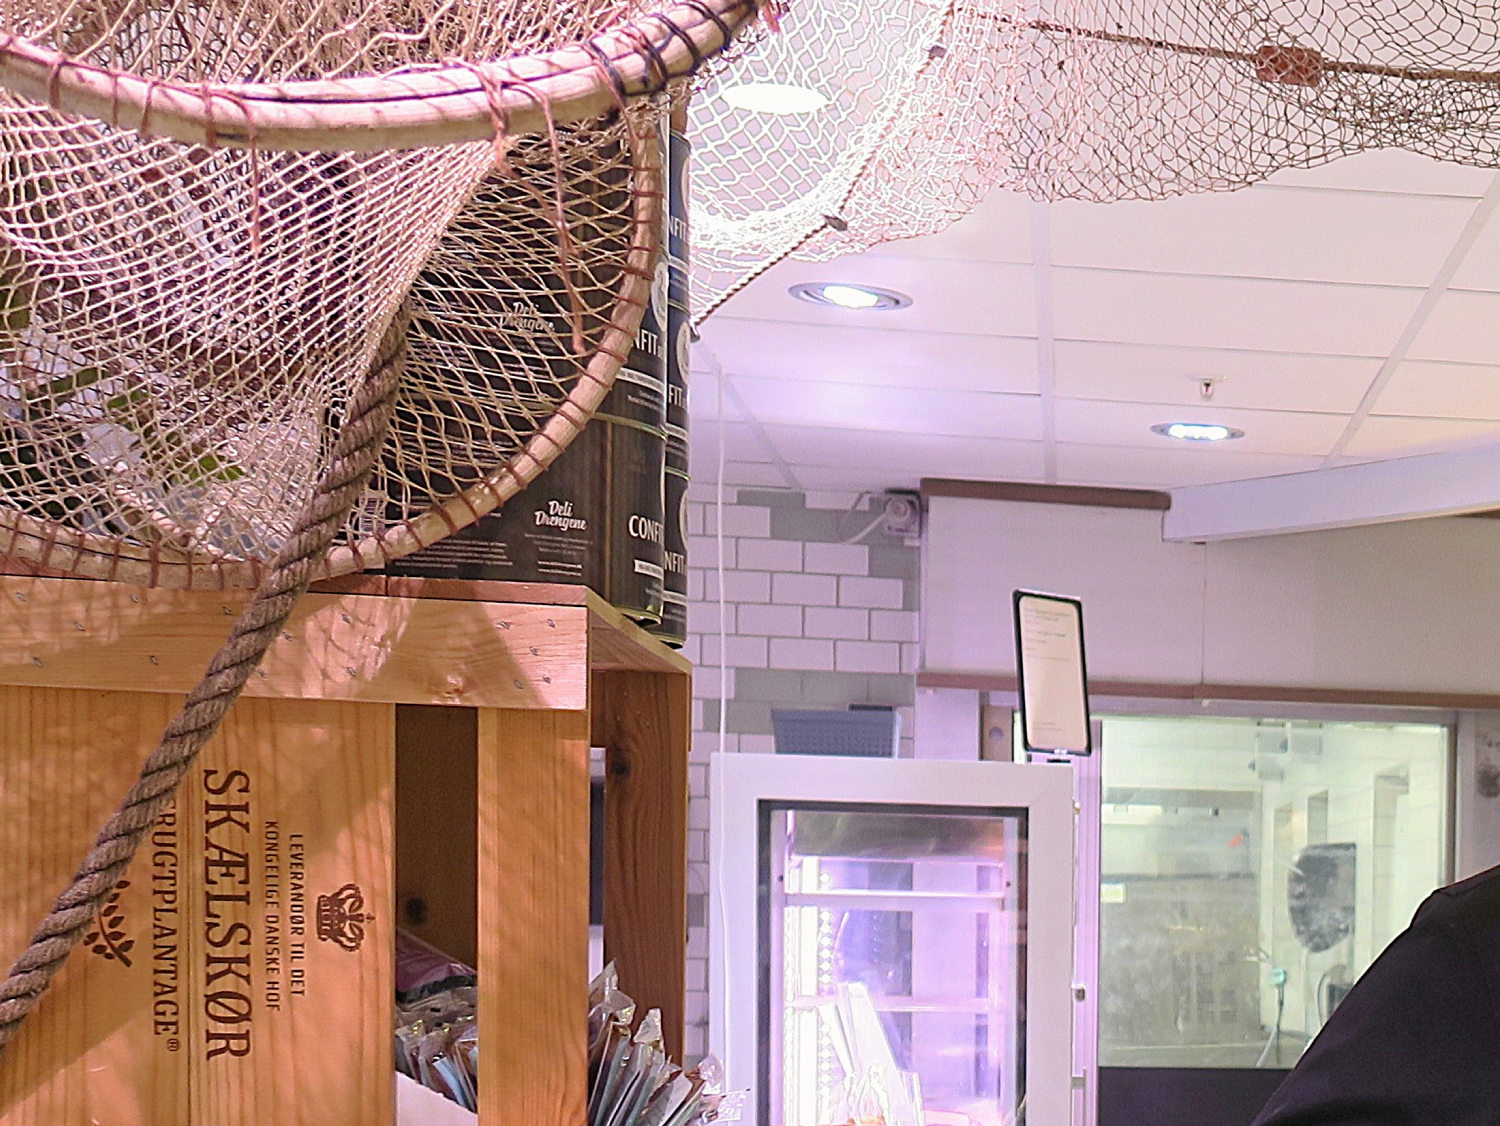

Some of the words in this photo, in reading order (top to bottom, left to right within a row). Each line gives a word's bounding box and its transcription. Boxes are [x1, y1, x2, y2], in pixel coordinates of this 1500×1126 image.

[534, 510, 588, 531] Drengene
[549, 500, 574, 517] Deli
[265, 821, 280, 905] KONGELIGE
[289, 834, 305, 936] LEVERANDØR
[204, 769, 252, 1061] SKÆLSKØR
[265, 915, 281, 975] DANSKE
[290, 943, 305, 962] TIL
[266, 982, 281, 1012] HOF
[291, 970, 306, 996] DET
